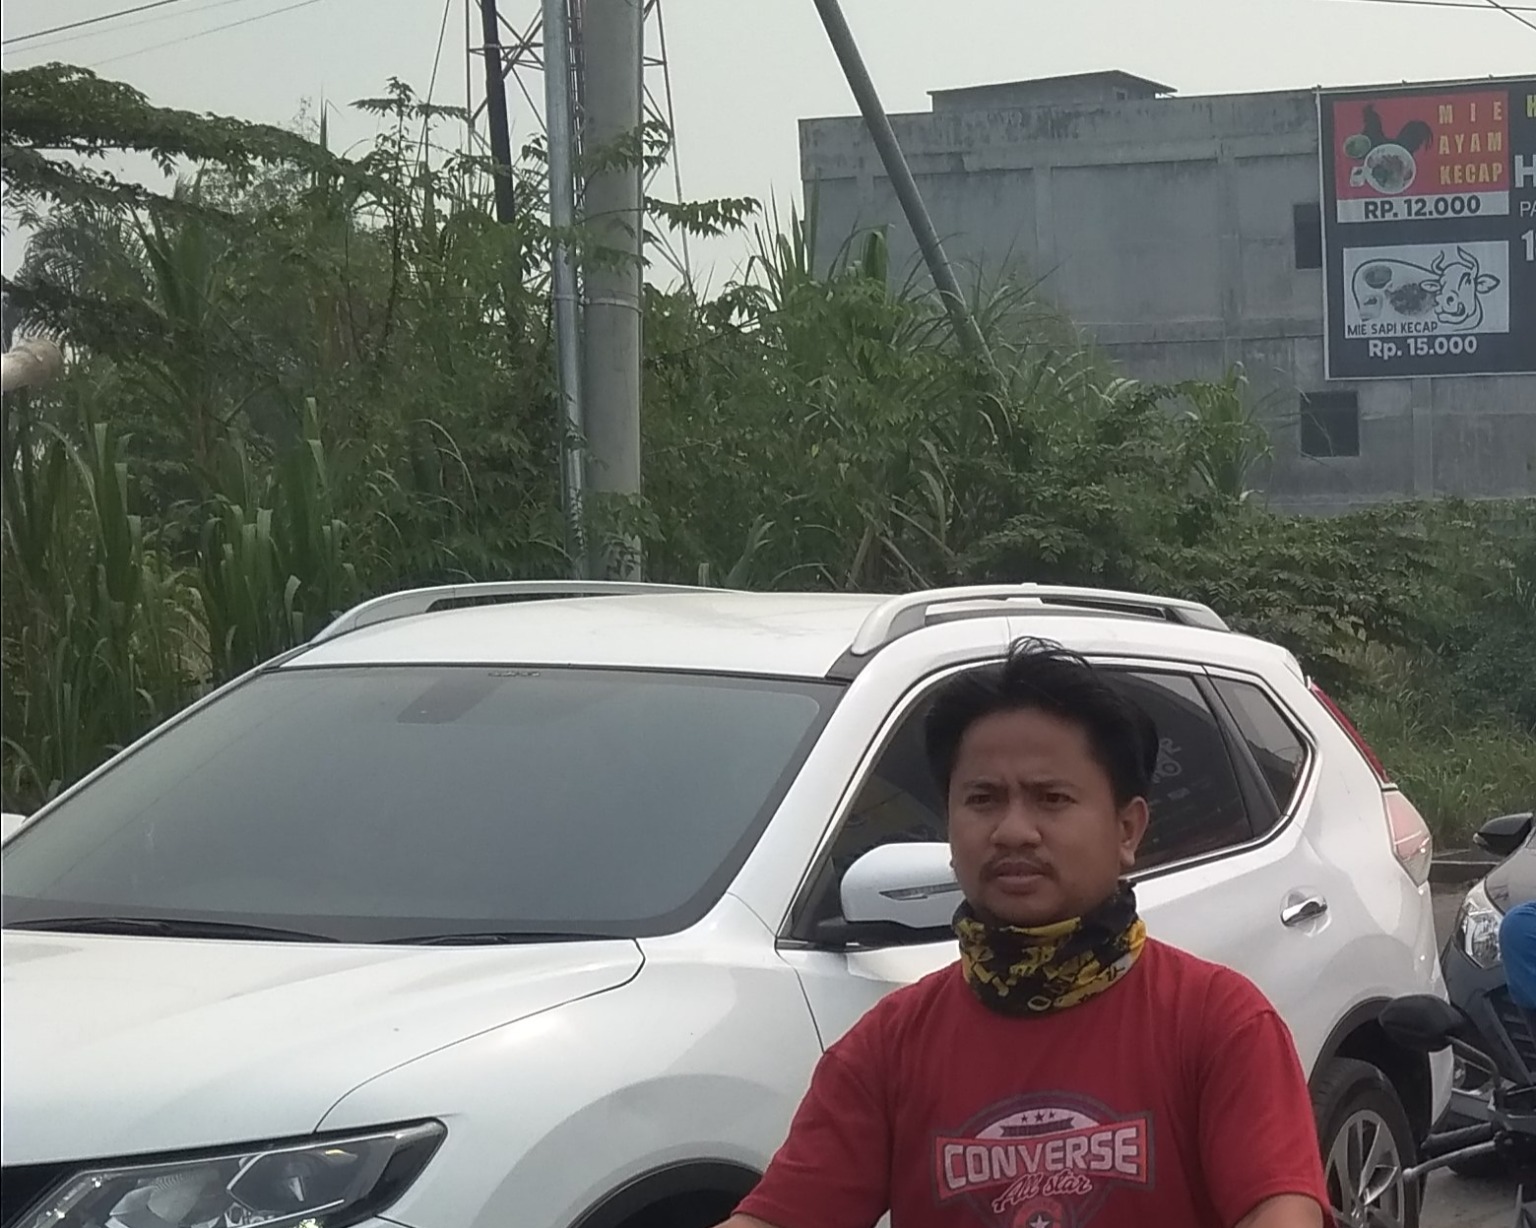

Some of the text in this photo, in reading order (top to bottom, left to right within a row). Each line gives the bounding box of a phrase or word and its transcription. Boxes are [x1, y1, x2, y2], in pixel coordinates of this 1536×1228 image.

[1438, 101, 1504, 124] MIE
[1438, 132, 1503, 156] AYAM
[1440, 163, 1504, 185] KECAP
[1364, 195, 1481, 219] RP. 12.000
[1347, 321, 1438, 336] MIE SAPI KECAP
[1368, 335, 1478, 360] Rp. 15.000
[944, 1127, 1138, 1189] CONVERSE
[991, 1172, 1043, 1214] All
